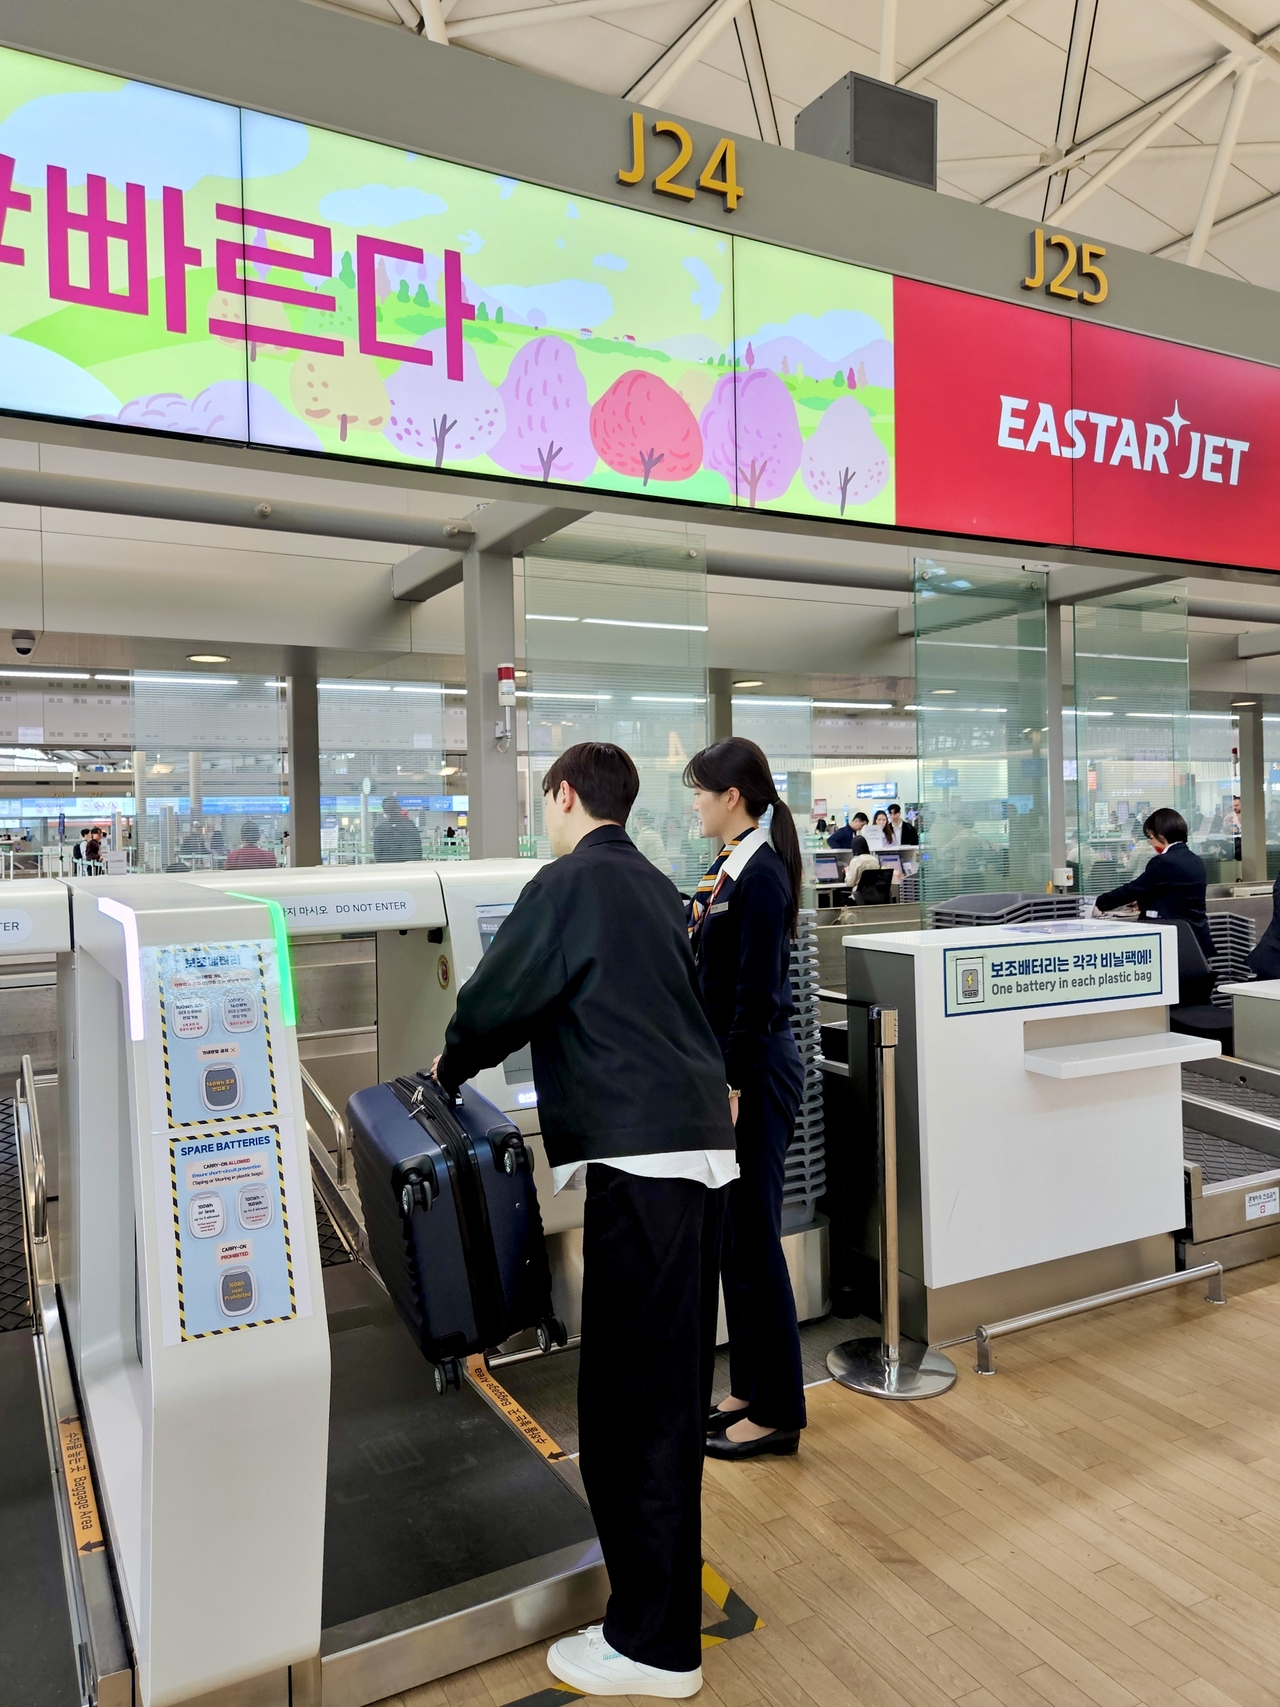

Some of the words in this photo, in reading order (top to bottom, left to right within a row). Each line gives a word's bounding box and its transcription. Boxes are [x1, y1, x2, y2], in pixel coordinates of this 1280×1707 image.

[617, 112, 744, 213] J24
[1020, 228, 1109, 304] J25
[998, 395, 1169, 475] EASTAR
[1179, 433, 1250, 486] JET
[299, 905, 328, 917] 마시오
[335, 904, 351, 914] DO
[353, 903, 373, 913] NOT
[375, 901, 407, 912] ENTER
[991, 956, 1070, 978] 보조배터리는
[1073, 953, 1098, 970] 각각
[1101, 948, 1152, 968] 비닐팩에!
[991, 983, 1013, 996] One
[1015, 978, 1056, 995] battery
[1058, 977, 1069, 989] in
[1071, 974, 1096, 988] each
[1098, 970, 1131, 988] plastic
[1134, 969, 1152, 983] bag
[181, 1143, 214, 1156] SPARE
[216, 1135, 271, 1151] BATTERIES
[208, 1167, 237, 1176] short-circuit
[238, 1164, 262, 1172] prevention
[221, 1244, 247, 1252] CARRY-ON
[221, 1251, 249, 1260] PROHIBITED
[224, 1291, 252, 1301] Prohibited
[474, 1367, 489, 1383] Area
[486, 1382, 512, 1407] Baggage
[65, 1432, 82, 1451] 수하물
[67, 1450, 84, 1465] 놓는
[70, 1465, 86, 1474] 곳
[72, 1476, 89, 1510] Baggage
[80, 1510, 94, 1531] Area
